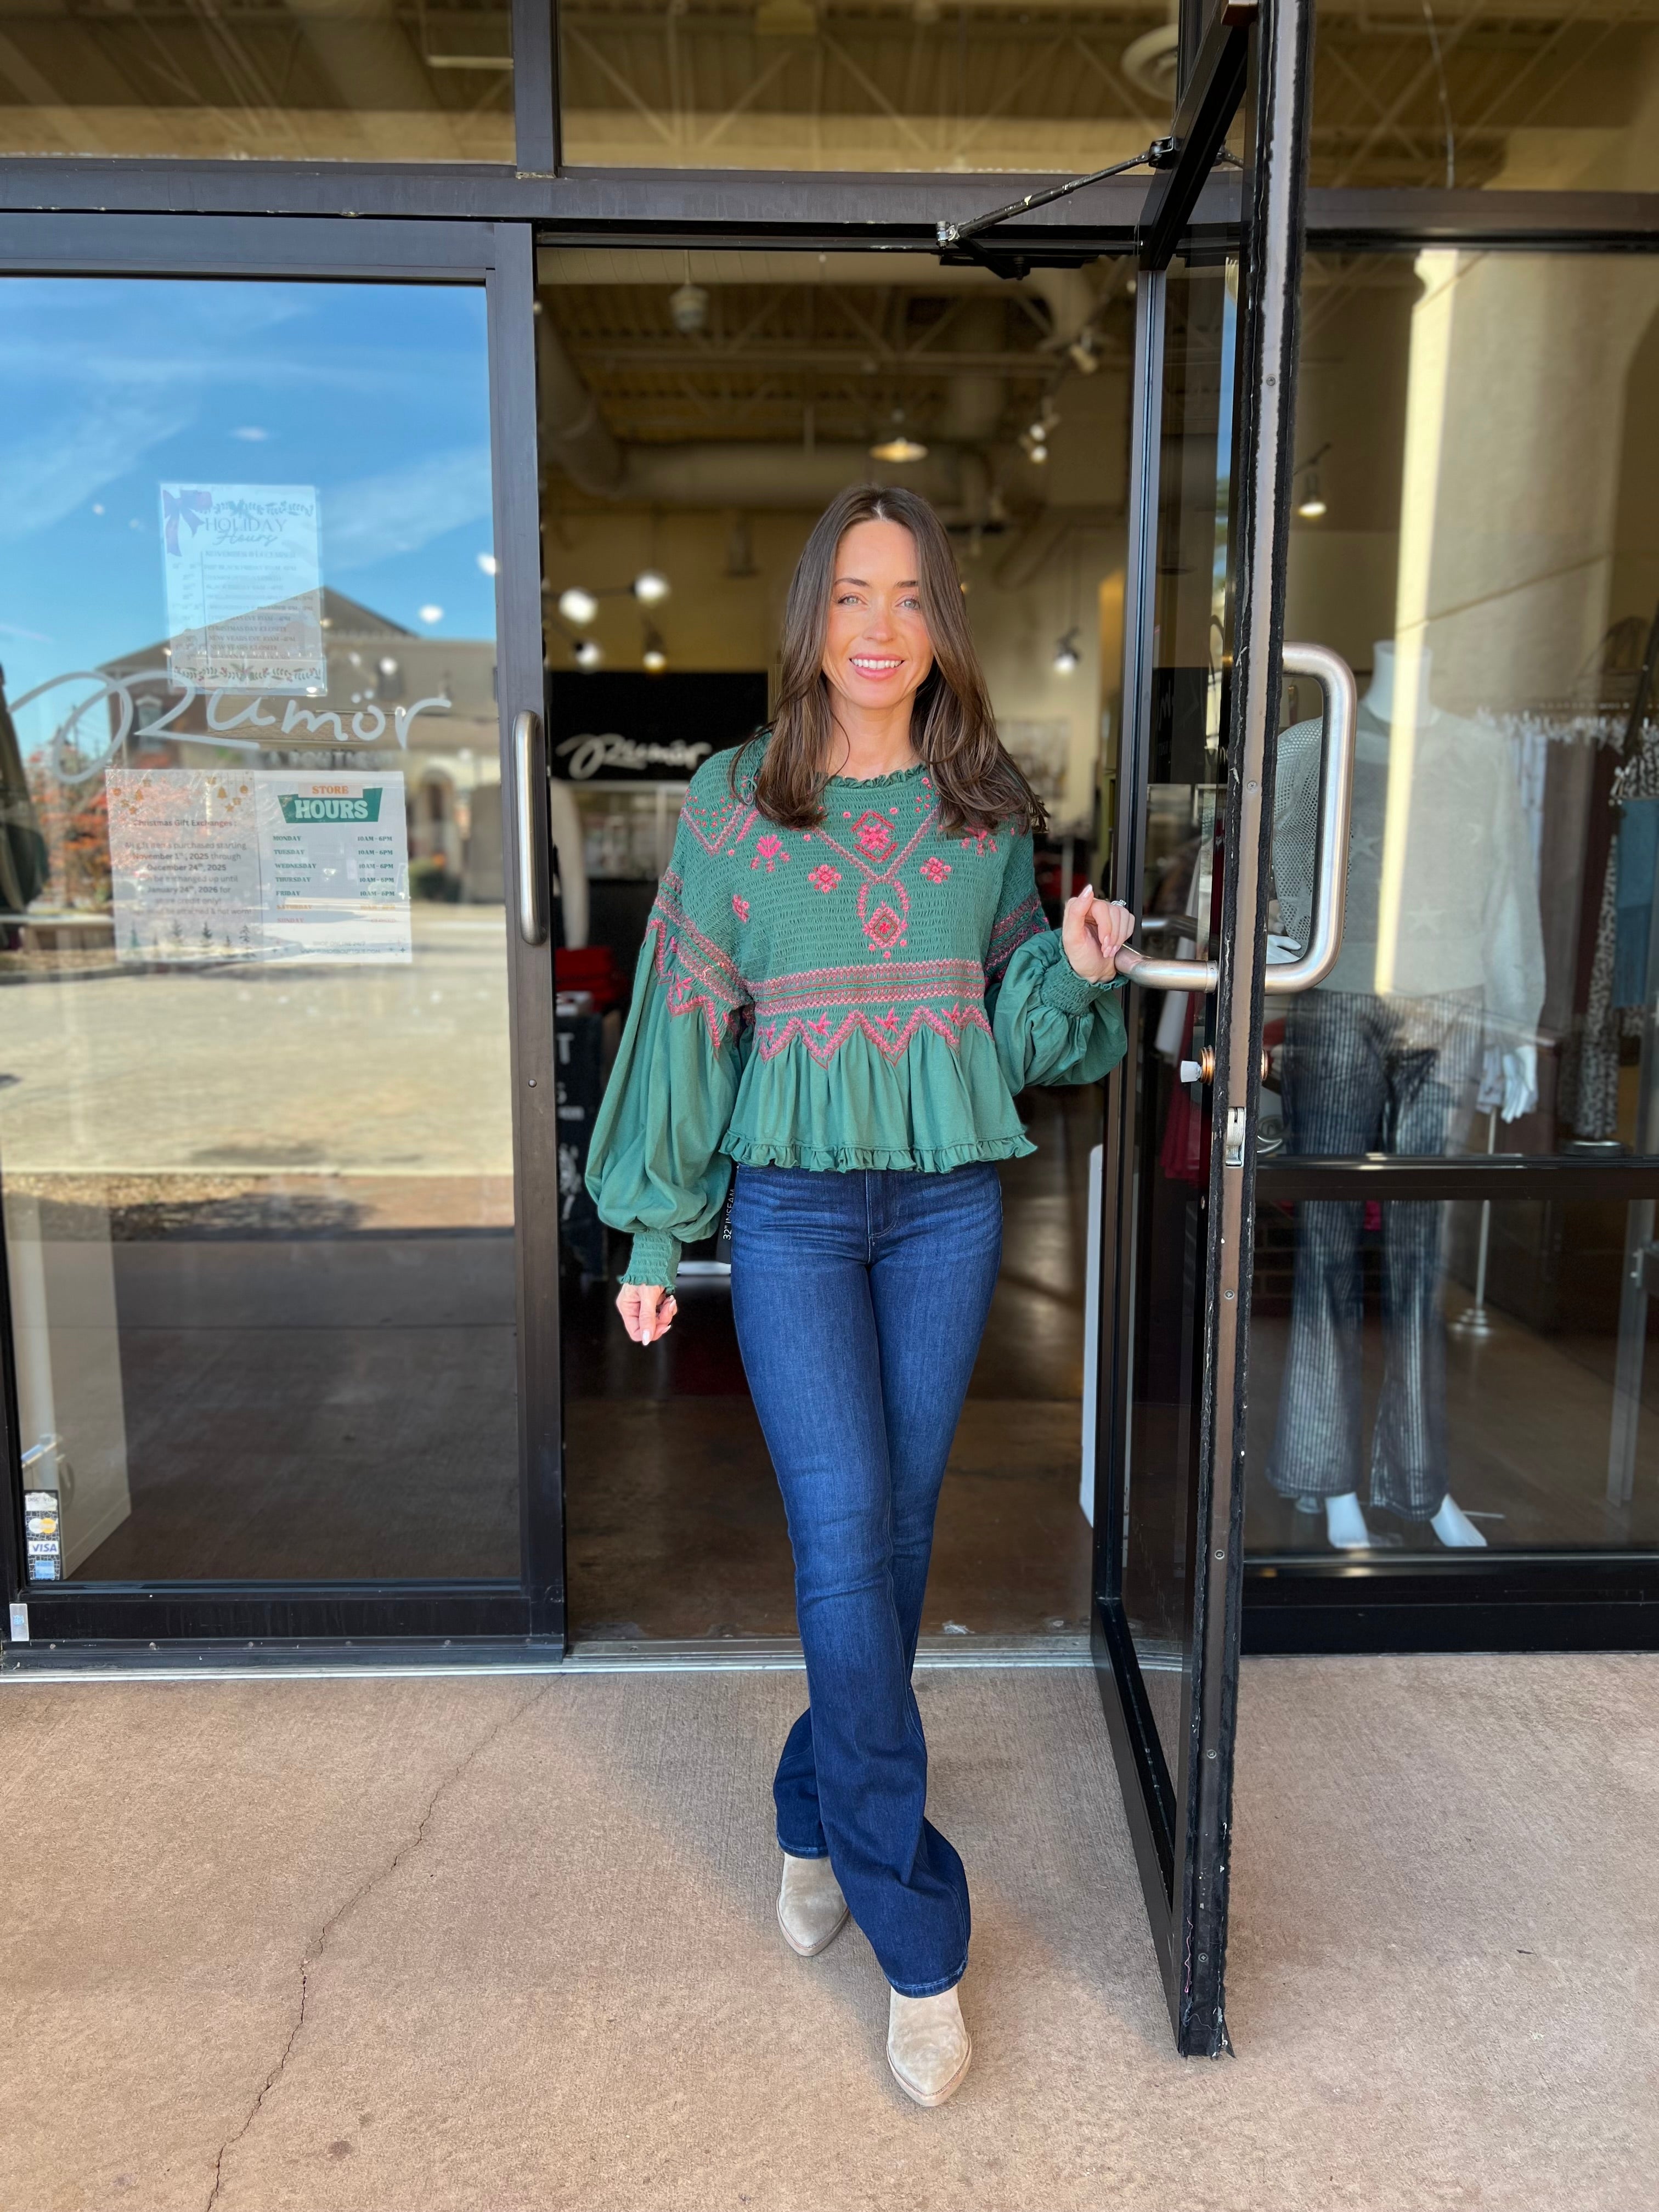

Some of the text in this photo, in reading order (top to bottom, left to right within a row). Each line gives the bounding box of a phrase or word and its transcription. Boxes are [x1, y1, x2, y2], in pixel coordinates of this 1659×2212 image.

[205, 517, 286, 532] HOLIDAY
[213, 529, 278, 547] Hours
[311, 785, 349, 794] STORE
[294, 799, 369, 820] HOURS
[191, 819, 233, 828] Exchanges
[173, 842, 214, 850] purchased
[211, 853, 241, 862] through
[147, 886, 177, 894] January
[32, 1544, 57, 1552] VISA
